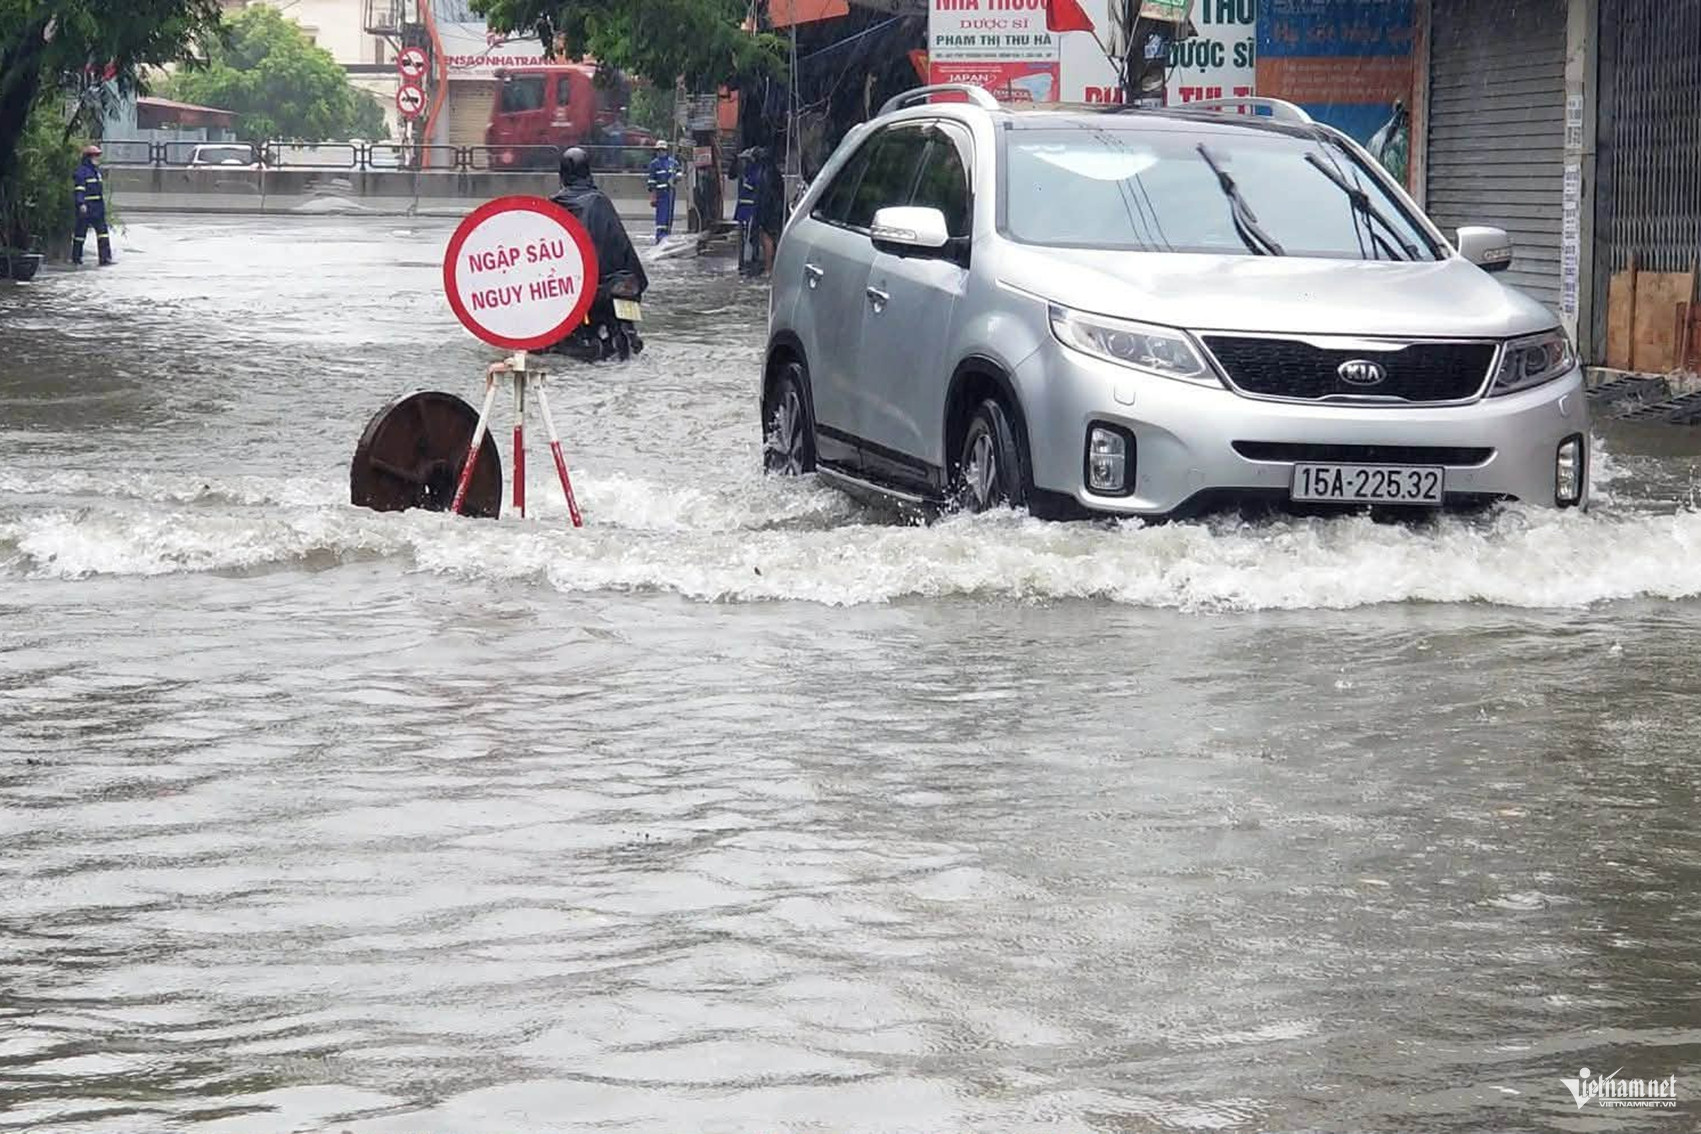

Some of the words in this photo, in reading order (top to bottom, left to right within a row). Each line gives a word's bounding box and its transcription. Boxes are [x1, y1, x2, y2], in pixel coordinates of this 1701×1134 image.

[1006, 35, 1029, 46] THU
[1034, 33, 1052, 46] HÀ
[948, 73, 989, 83] JAPAN
[468, 244, 520, 274] NGẬP
[526, 238, 564, 263] SÂU
[471, 284, 523, 311] NGUY
[529, 267, 575, 301] HIỂM
[1346, 364, 1380, 380] KIA
[1302, 467, 1439, 500] 15A-225.32
